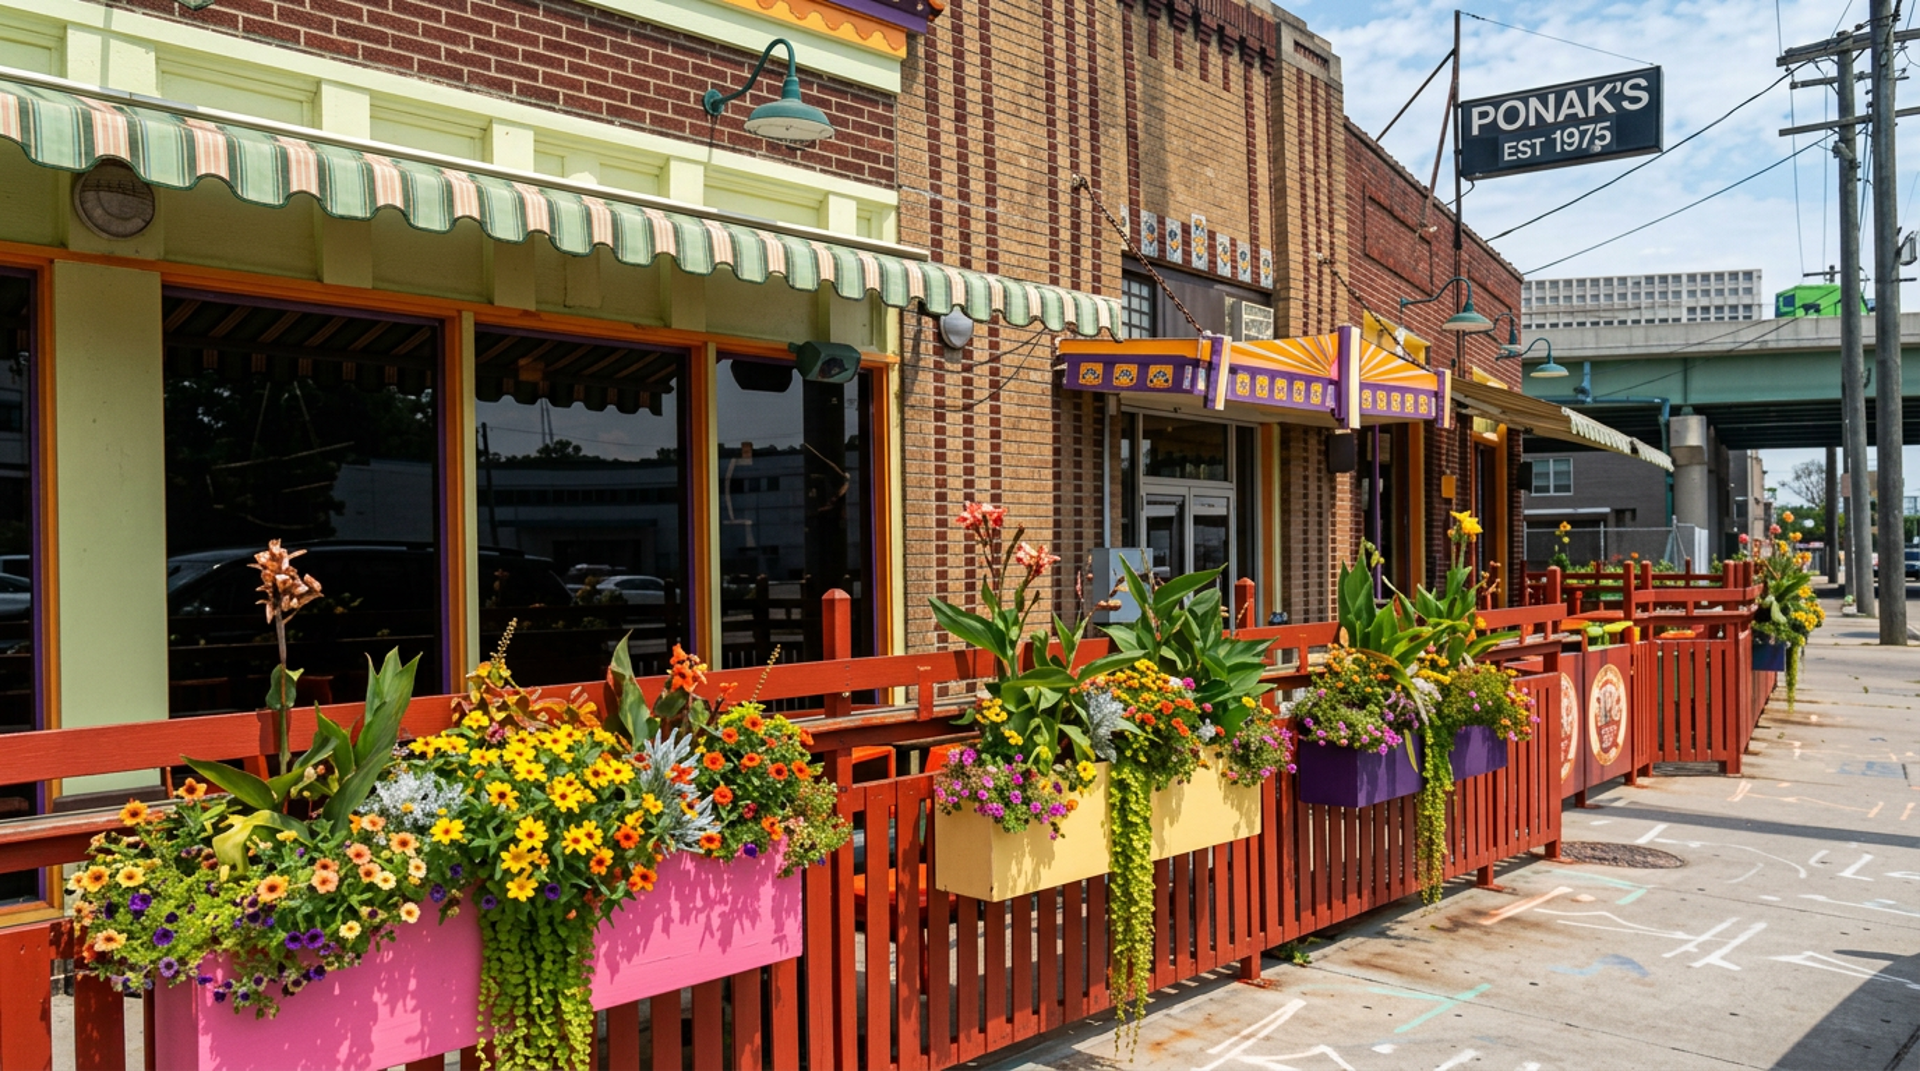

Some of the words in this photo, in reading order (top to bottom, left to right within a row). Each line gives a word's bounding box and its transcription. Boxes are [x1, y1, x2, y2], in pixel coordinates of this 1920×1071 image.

[1471, 77, 1650, 136] PONAK'S
[1503, 137, 1545, 161] EST
[1551, 121, 1612, 153] 1975
